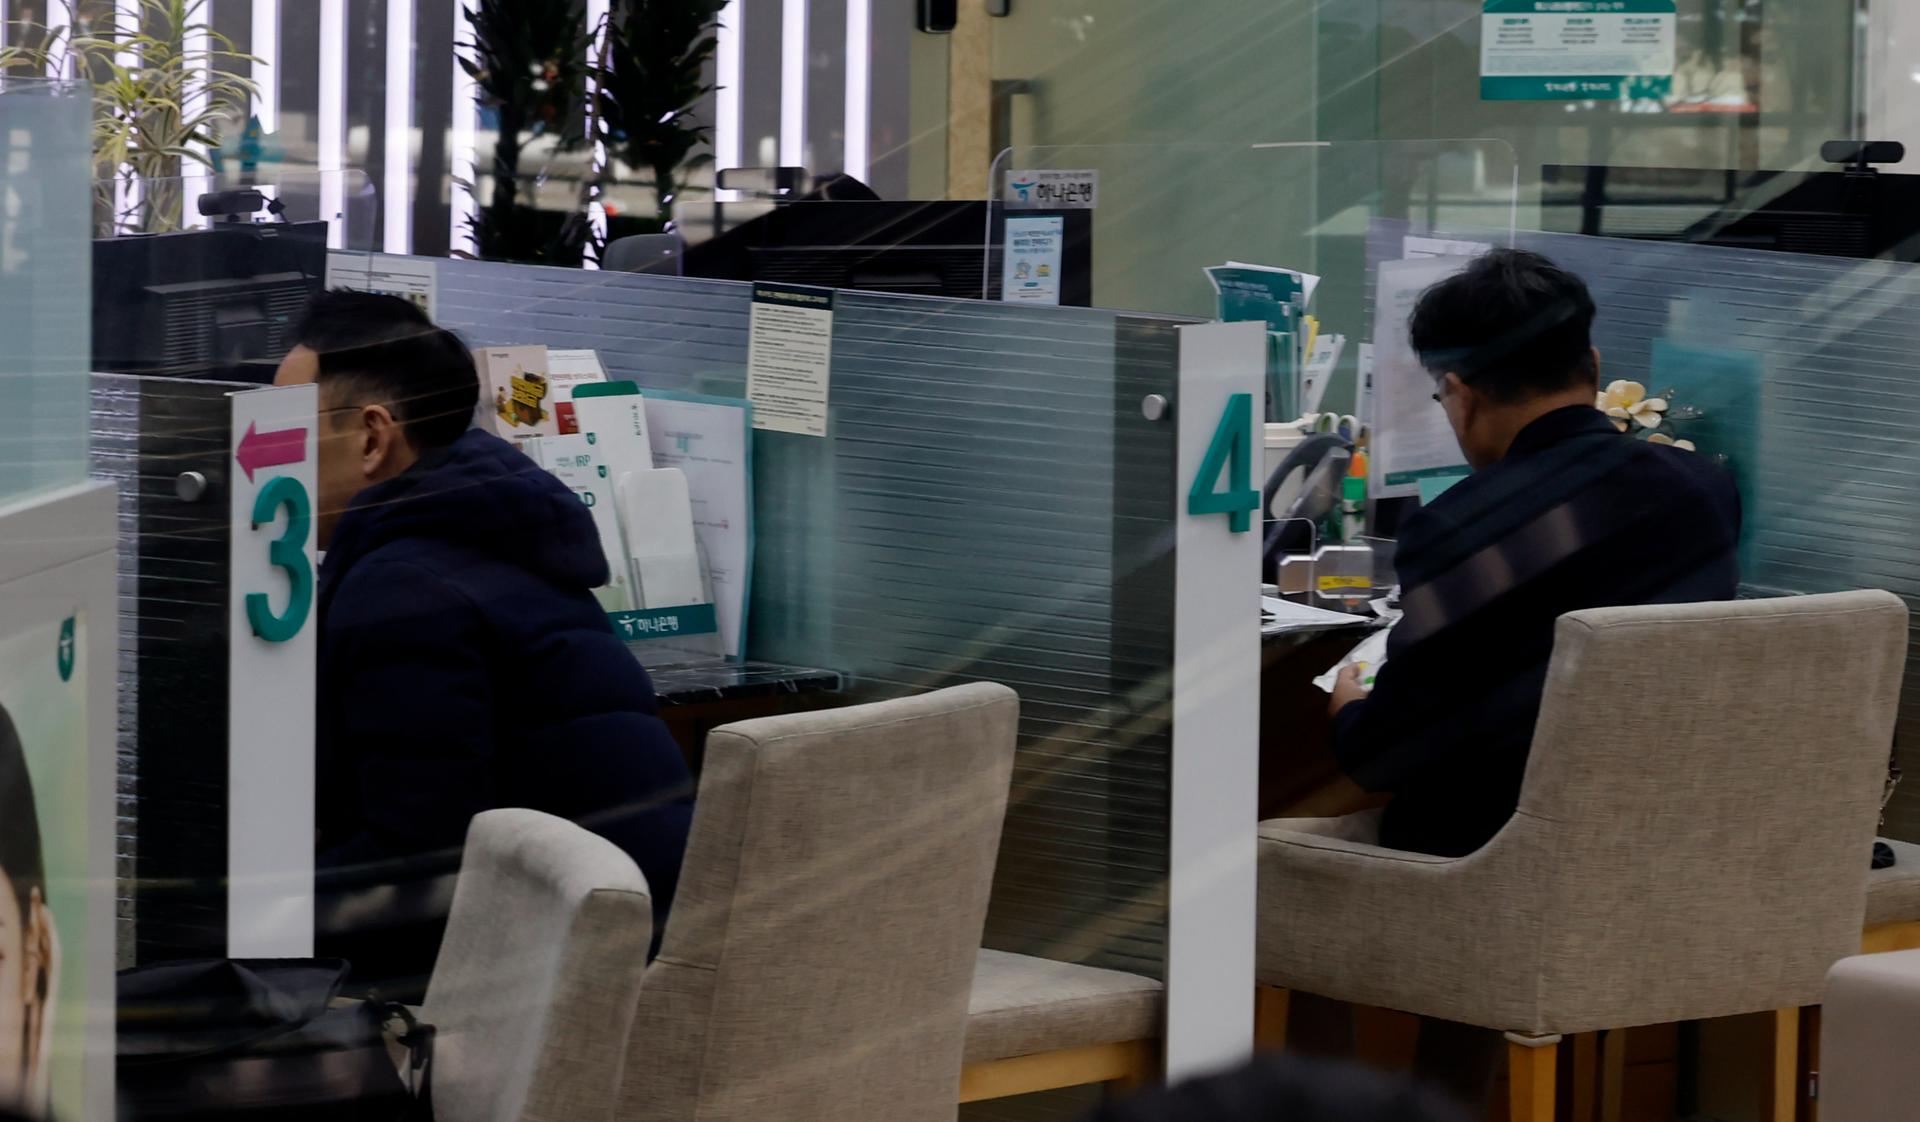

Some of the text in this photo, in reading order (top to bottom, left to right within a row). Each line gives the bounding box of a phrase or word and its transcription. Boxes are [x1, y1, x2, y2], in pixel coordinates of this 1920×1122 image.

[1036, 182, 1094, 202] 하나은행
[1188, 393, 1260, 533] 4
[246, 476, 313, 642] 3
[637, 615, 679, 632] 하나은행
